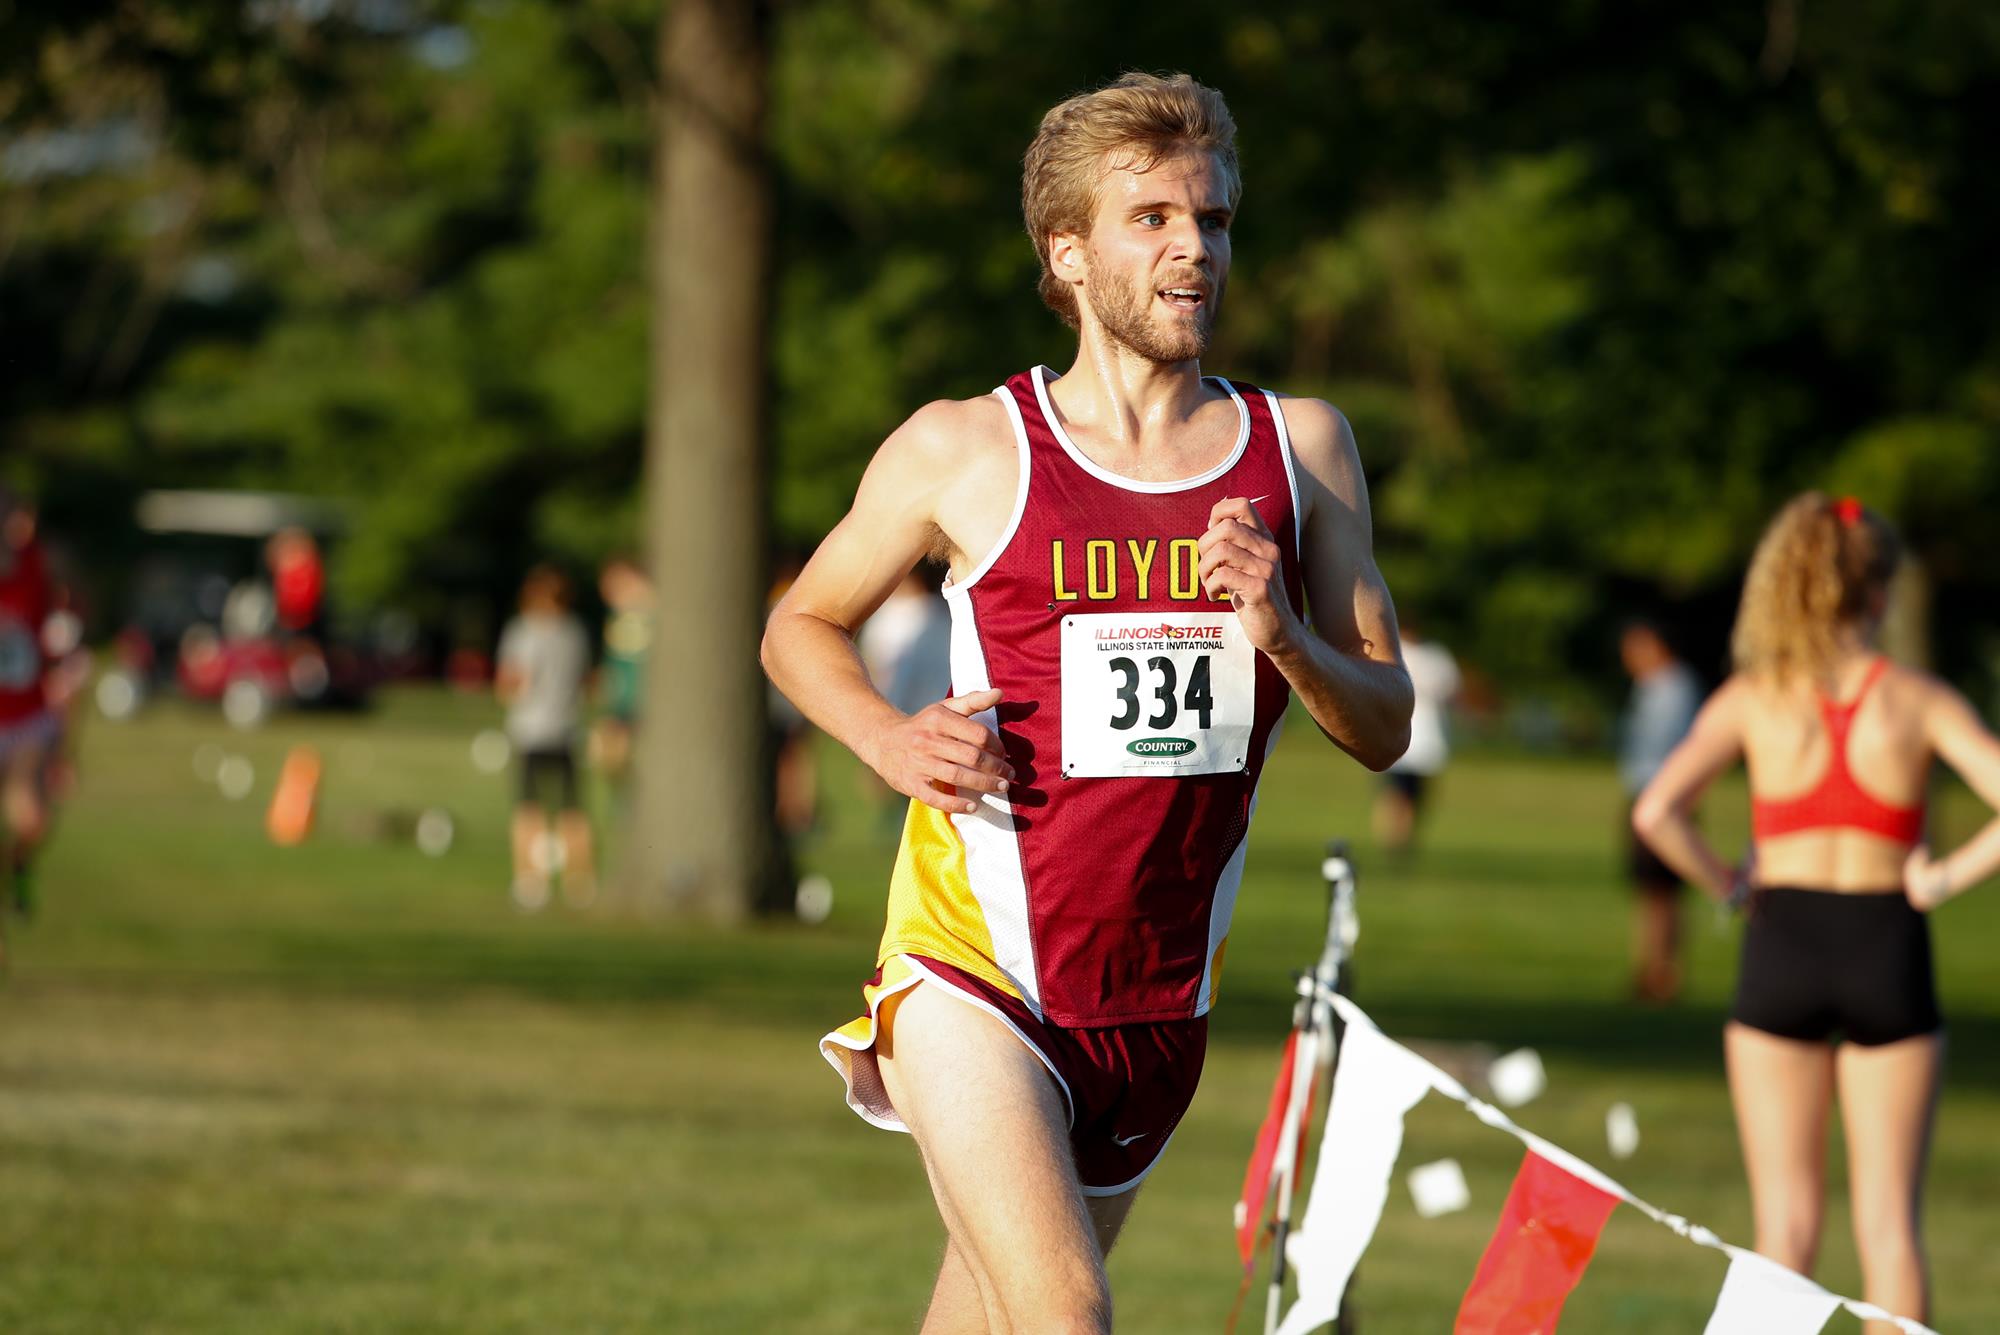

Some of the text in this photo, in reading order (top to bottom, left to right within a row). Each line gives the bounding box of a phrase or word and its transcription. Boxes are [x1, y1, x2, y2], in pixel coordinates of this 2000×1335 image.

[1051, 538, 1232, 601] LOYO
[1095, 626, 1223, 640] ILLINOIS STATE
[1097, 641, 1224, 651] ILLINOIS STATE INVITATIONAL
[1109, 655, 1213, 730] 334
[1135, 742, 1189, 752] COUNTRY
